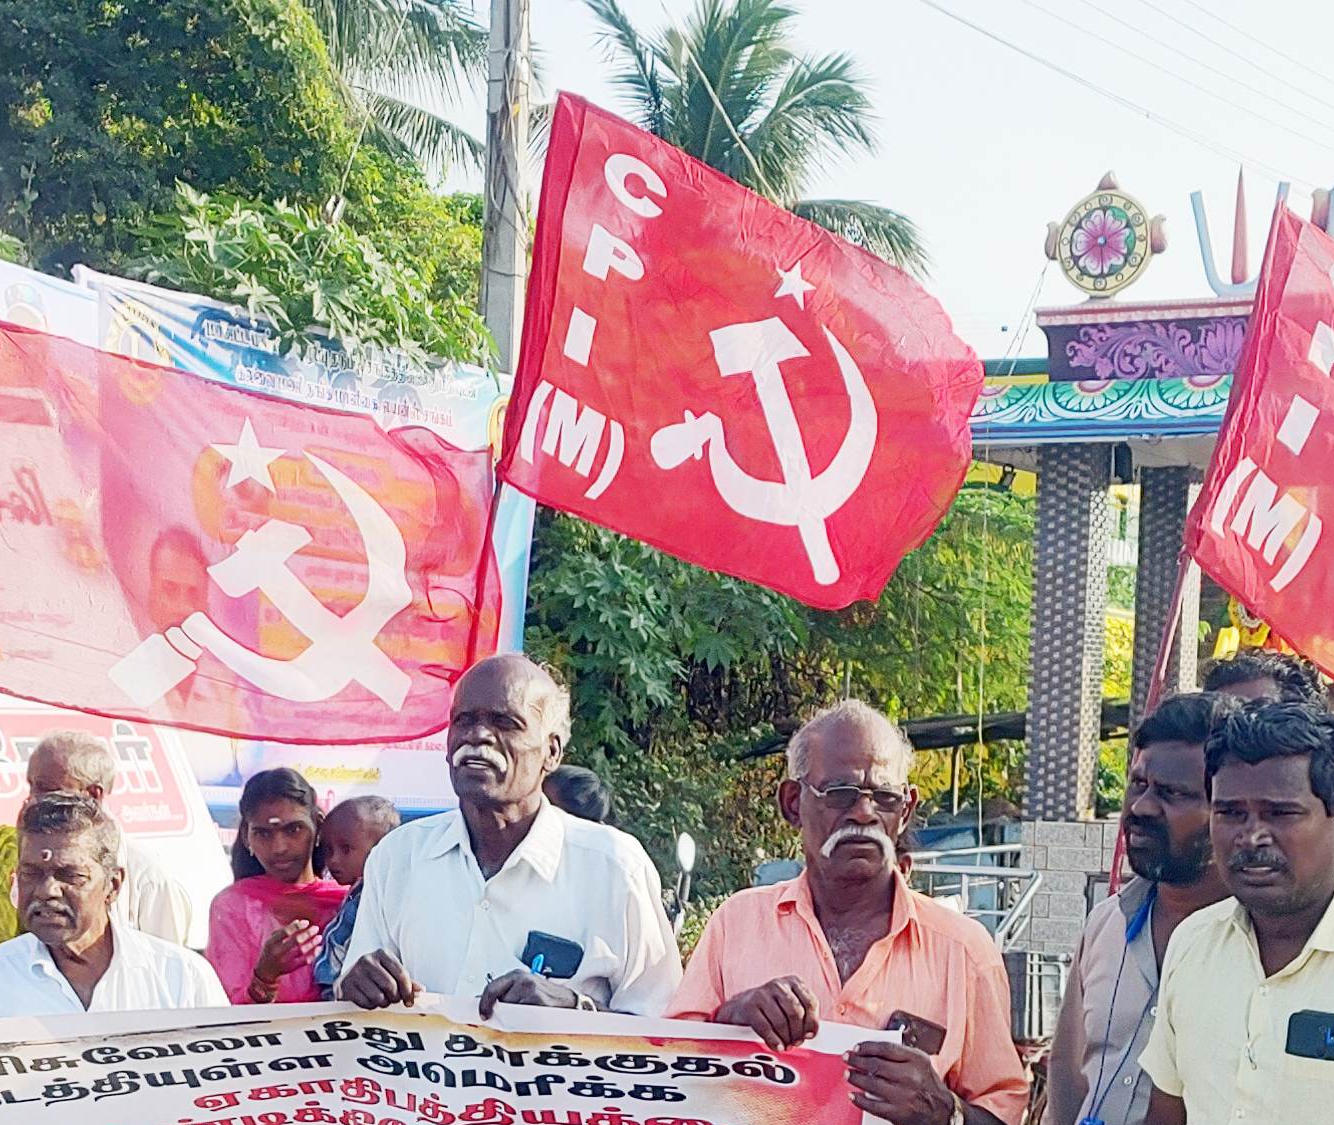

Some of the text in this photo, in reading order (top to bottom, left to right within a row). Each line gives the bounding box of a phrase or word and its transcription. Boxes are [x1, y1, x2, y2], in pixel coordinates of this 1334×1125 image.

[304, 1020, 425, 1054] மீது
[444, 1032, 800, 1086] தாக்குதல்
[356, 1054, 687, 1103] அமெரிக்க
